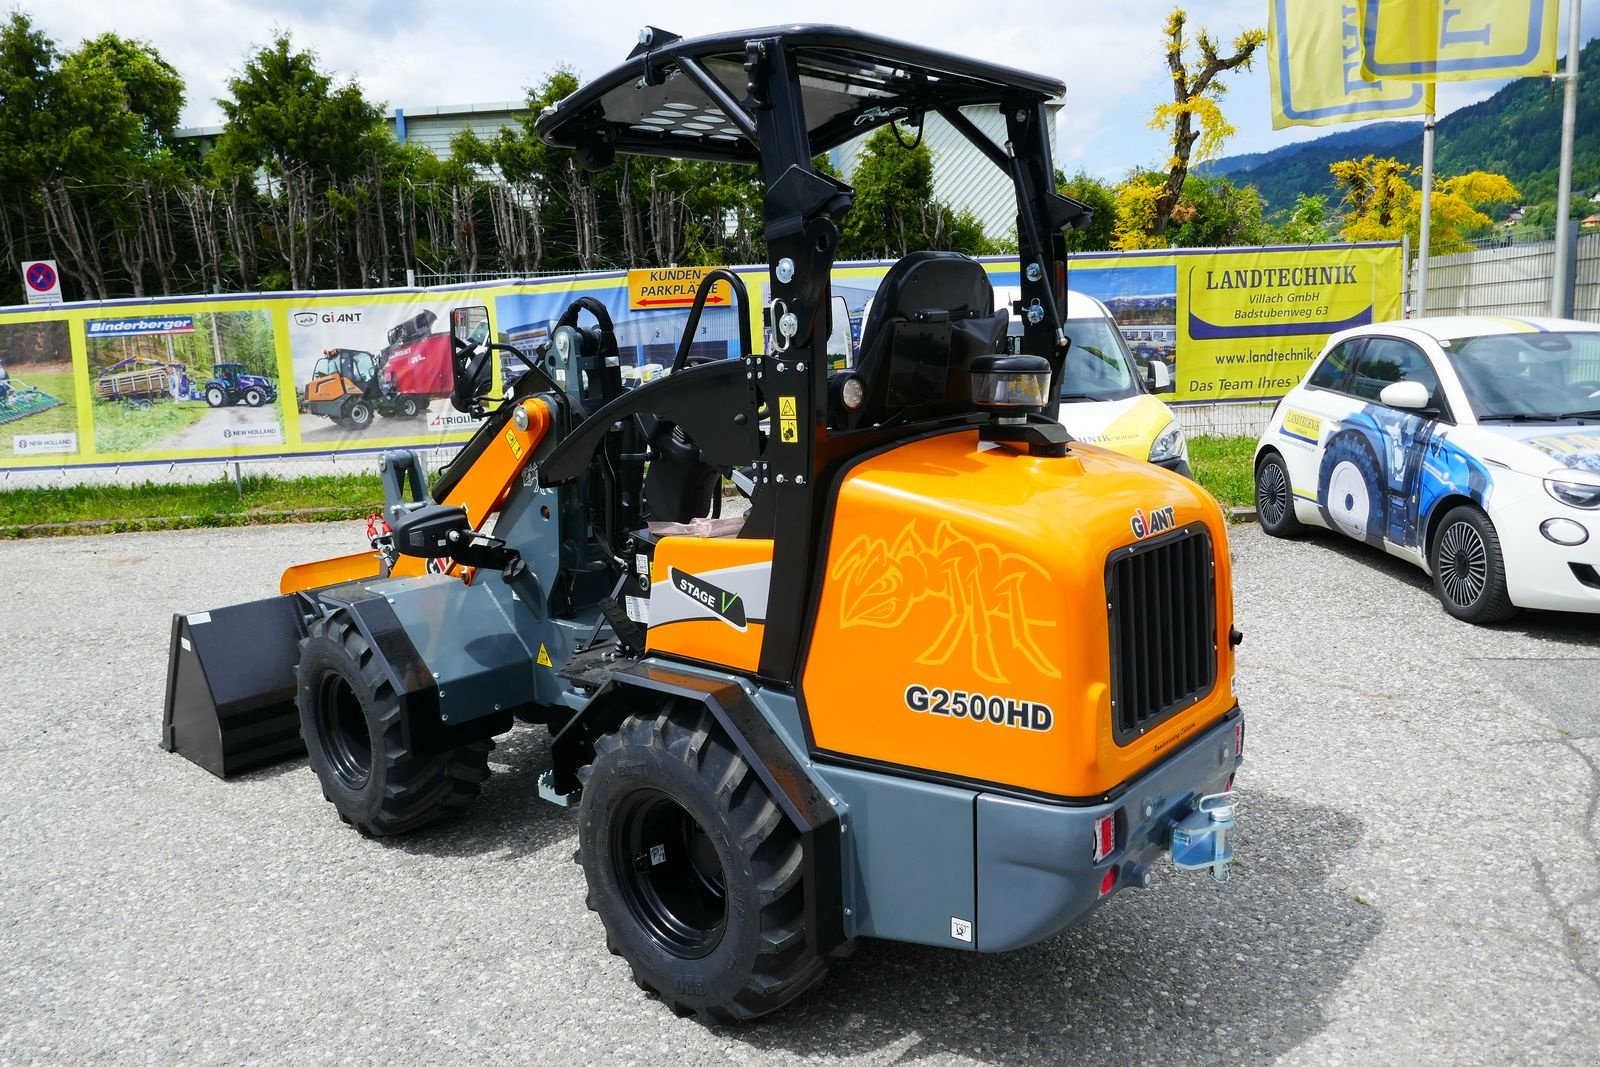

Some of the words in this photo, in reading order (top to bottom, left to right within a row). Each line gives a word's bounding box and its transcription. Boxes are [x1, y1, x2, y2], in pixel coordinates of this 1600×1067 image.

[650, 270, 707, 281] KUNDEN-
[1206, 265, 1357, 289] LANDTECHNIK
[641, 281, 718, 296] PARKPLÄE
[1249, 294, 1283, 304] Villach
[1287, 292, 1319, 302] GmbH
[1234, 307, 1312, 319] Badstubenweg
[1315, 306, 1328, 316] 63
[90, 318, 190, 331] Binderberger
[1190, 378, 1213, 392] Das
[1218, 376, 1253, 391] Team
[1257, 375, 1291, 388] Ihres
[680, 579, 715, 608] STAGE
[722, 592, 740, 614] V
[905, 684, 1054, 732] G2500HD
